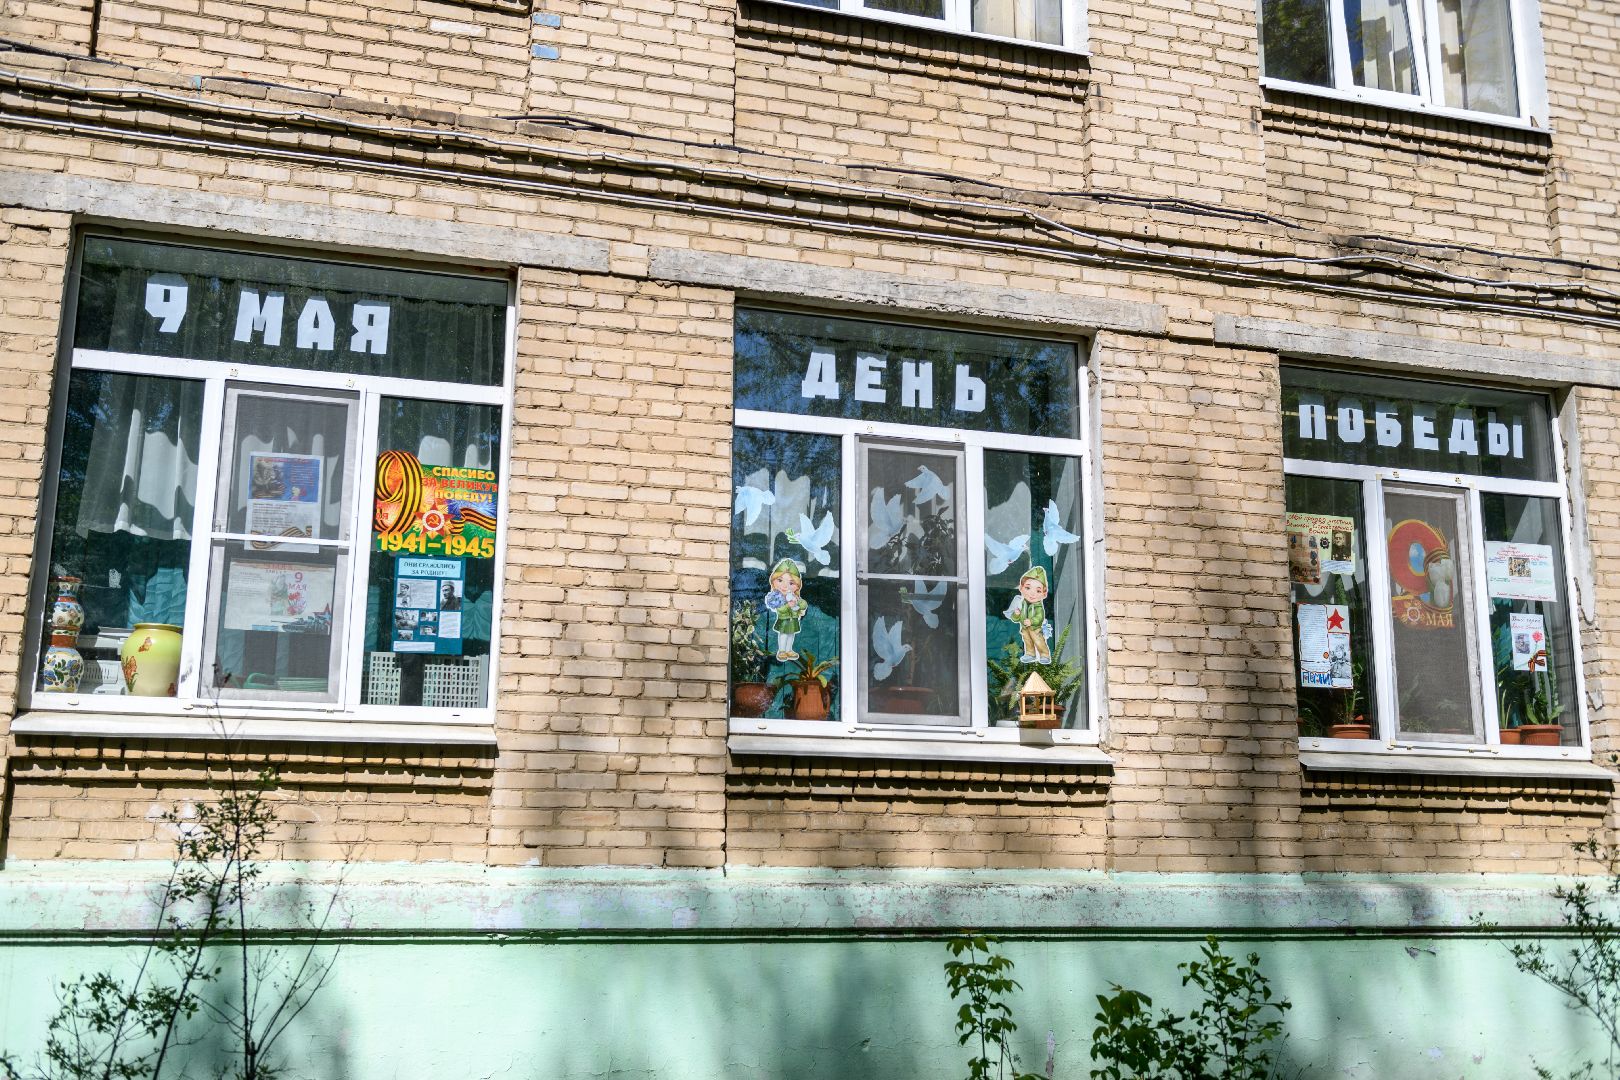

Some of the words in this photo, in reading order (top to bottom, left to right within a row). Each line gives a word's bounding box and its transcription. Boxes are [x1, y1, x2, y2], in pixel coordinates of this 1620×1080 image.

[144, 272, 189, 333] 9
[233, 287, 391, 355] МАЯ
[801, 346, 986, 413] ДЕНЬ
[1298, 392, 1524, 459] ПОБЕДЫ
[432, 466, 495, 480] СПАСИБО
[422, 477, 437, 487] ЗА
[434, 490, 493, 503] ПОБЕДУ!
[294, 571, 304, 583] 9
[1425, 612, 1453, 627] МАЯ
